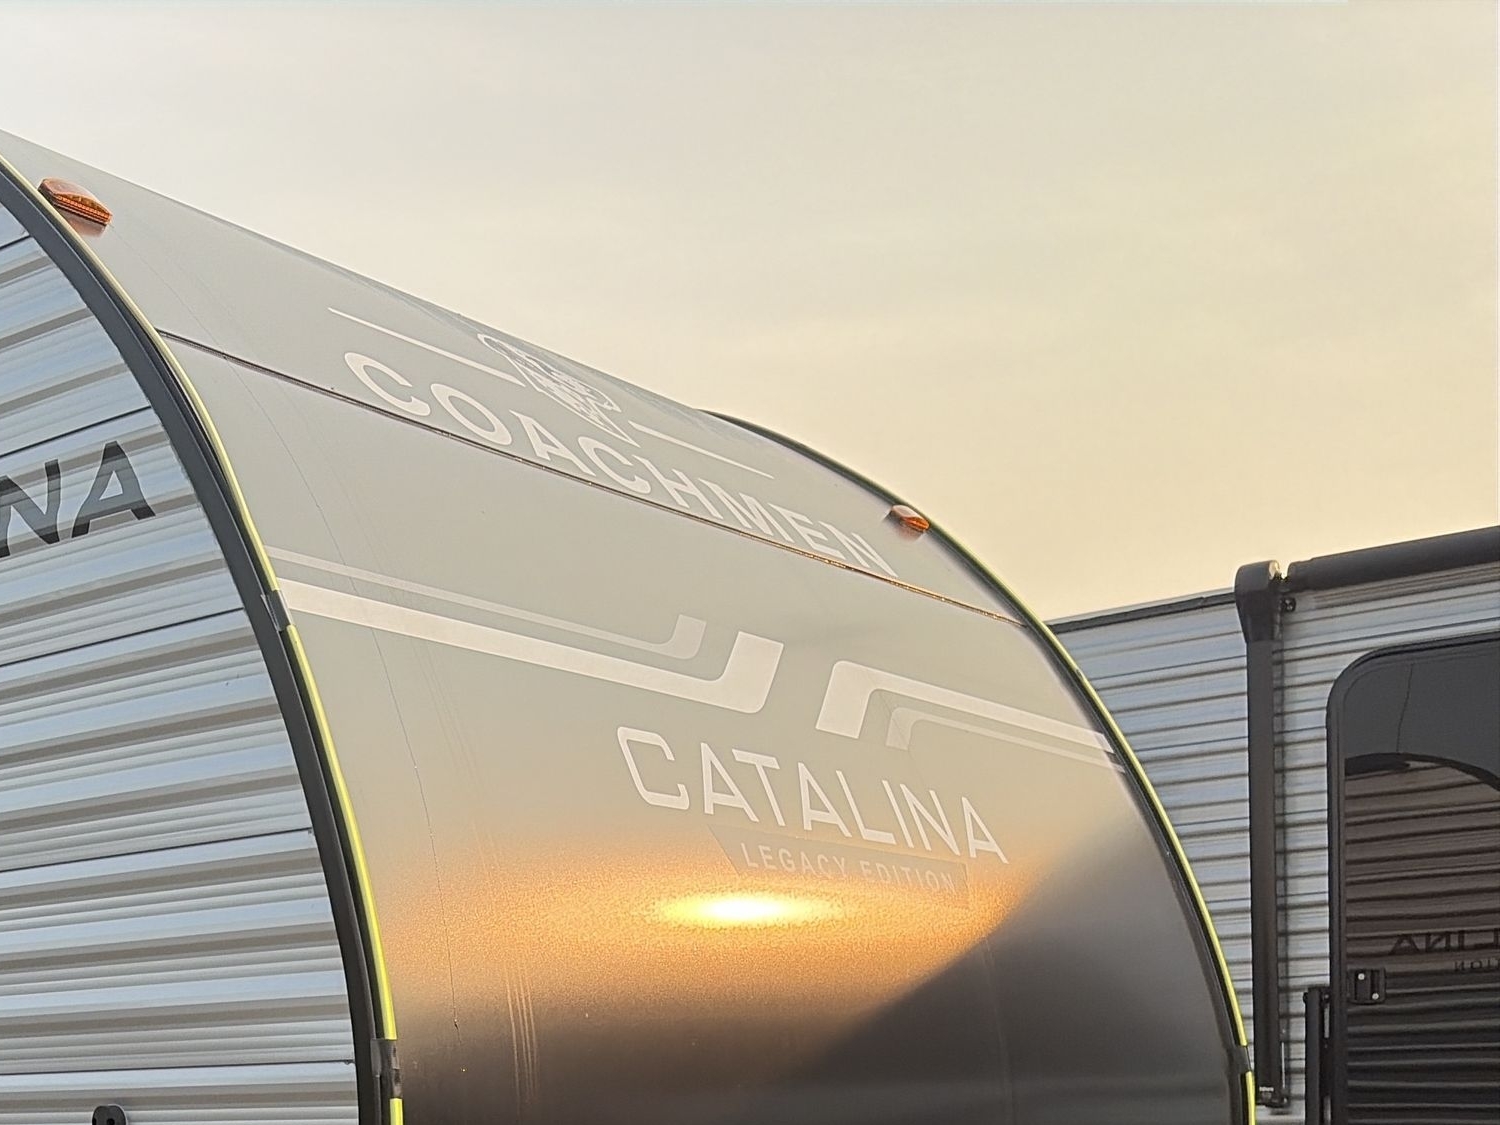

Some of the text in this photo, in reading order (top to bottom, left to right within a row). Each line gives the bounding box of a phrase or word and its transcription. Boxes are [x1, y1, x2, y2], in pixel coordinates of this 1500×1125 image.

[344, 352, 899, 578] COACHMEN
[616, 726, 1010, 865] CATALINA
[740, 842, 958, 894] LEGACY EDITION
